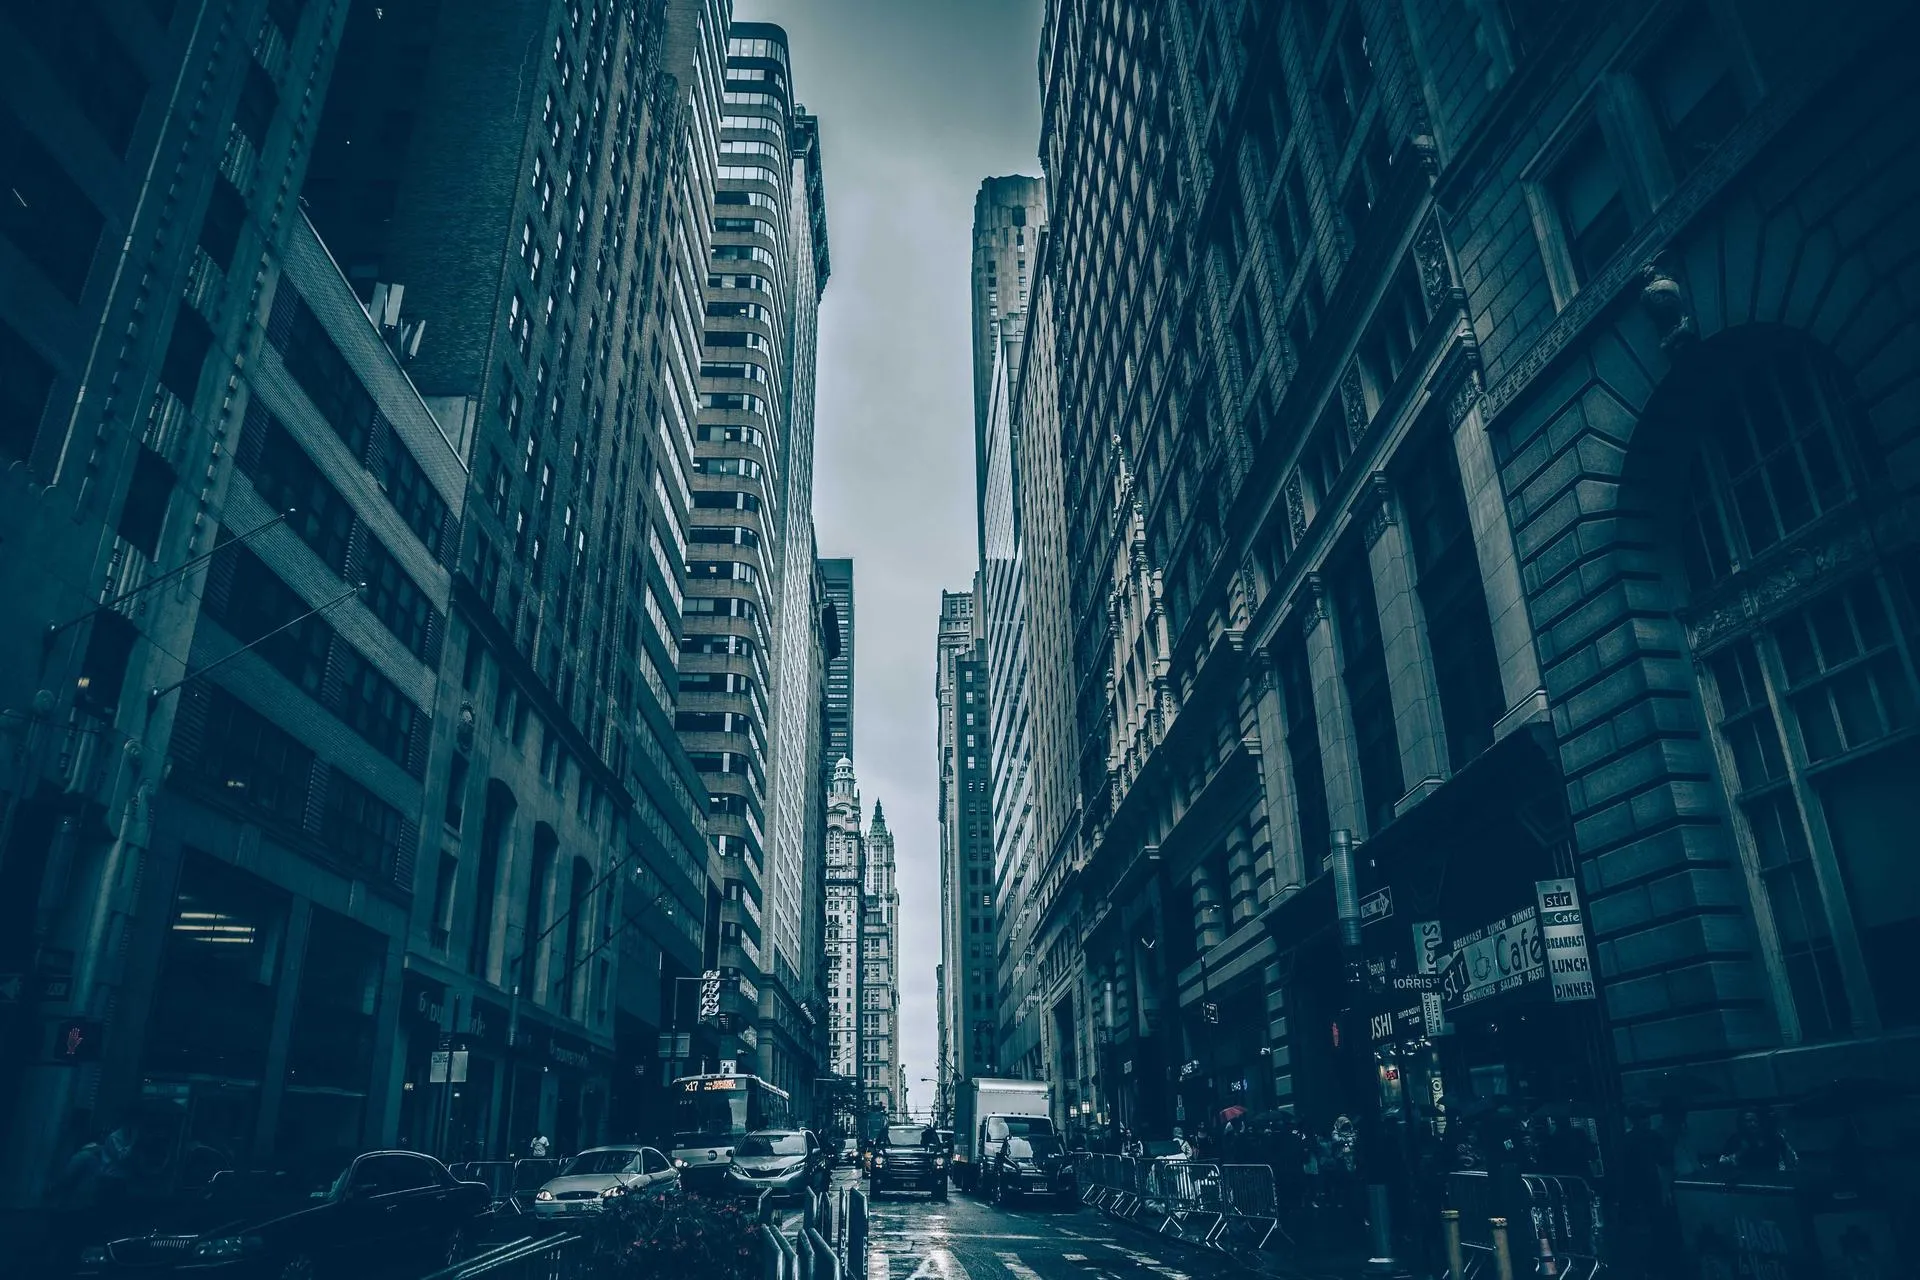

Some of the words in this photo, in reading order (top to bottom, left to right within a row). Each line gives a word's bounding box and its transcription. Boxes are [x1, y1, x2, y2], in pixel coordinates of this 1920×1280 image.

[1545, 894, 1569, 907] stir
[1553, 911, 1580, 924] Café
[1453, 929, 1482, 951] BREAKFAST
[1487, 918, 1507, 936] LUNCH
[1511, 906, 1536, 926] DINNER
[1545, 935, 1585, 950] BREAKFAST
[1444, 960, 1466, 1002] str
[1495, 927, 1544, 977] Café
[1551, 957, 1588, 974] LUNCH
[1462, 984, 1496, 1004] SANDWICHES
[1500, 974, 1523, 992] SALADS
[1554, 982, 1594, 999] DINNER
